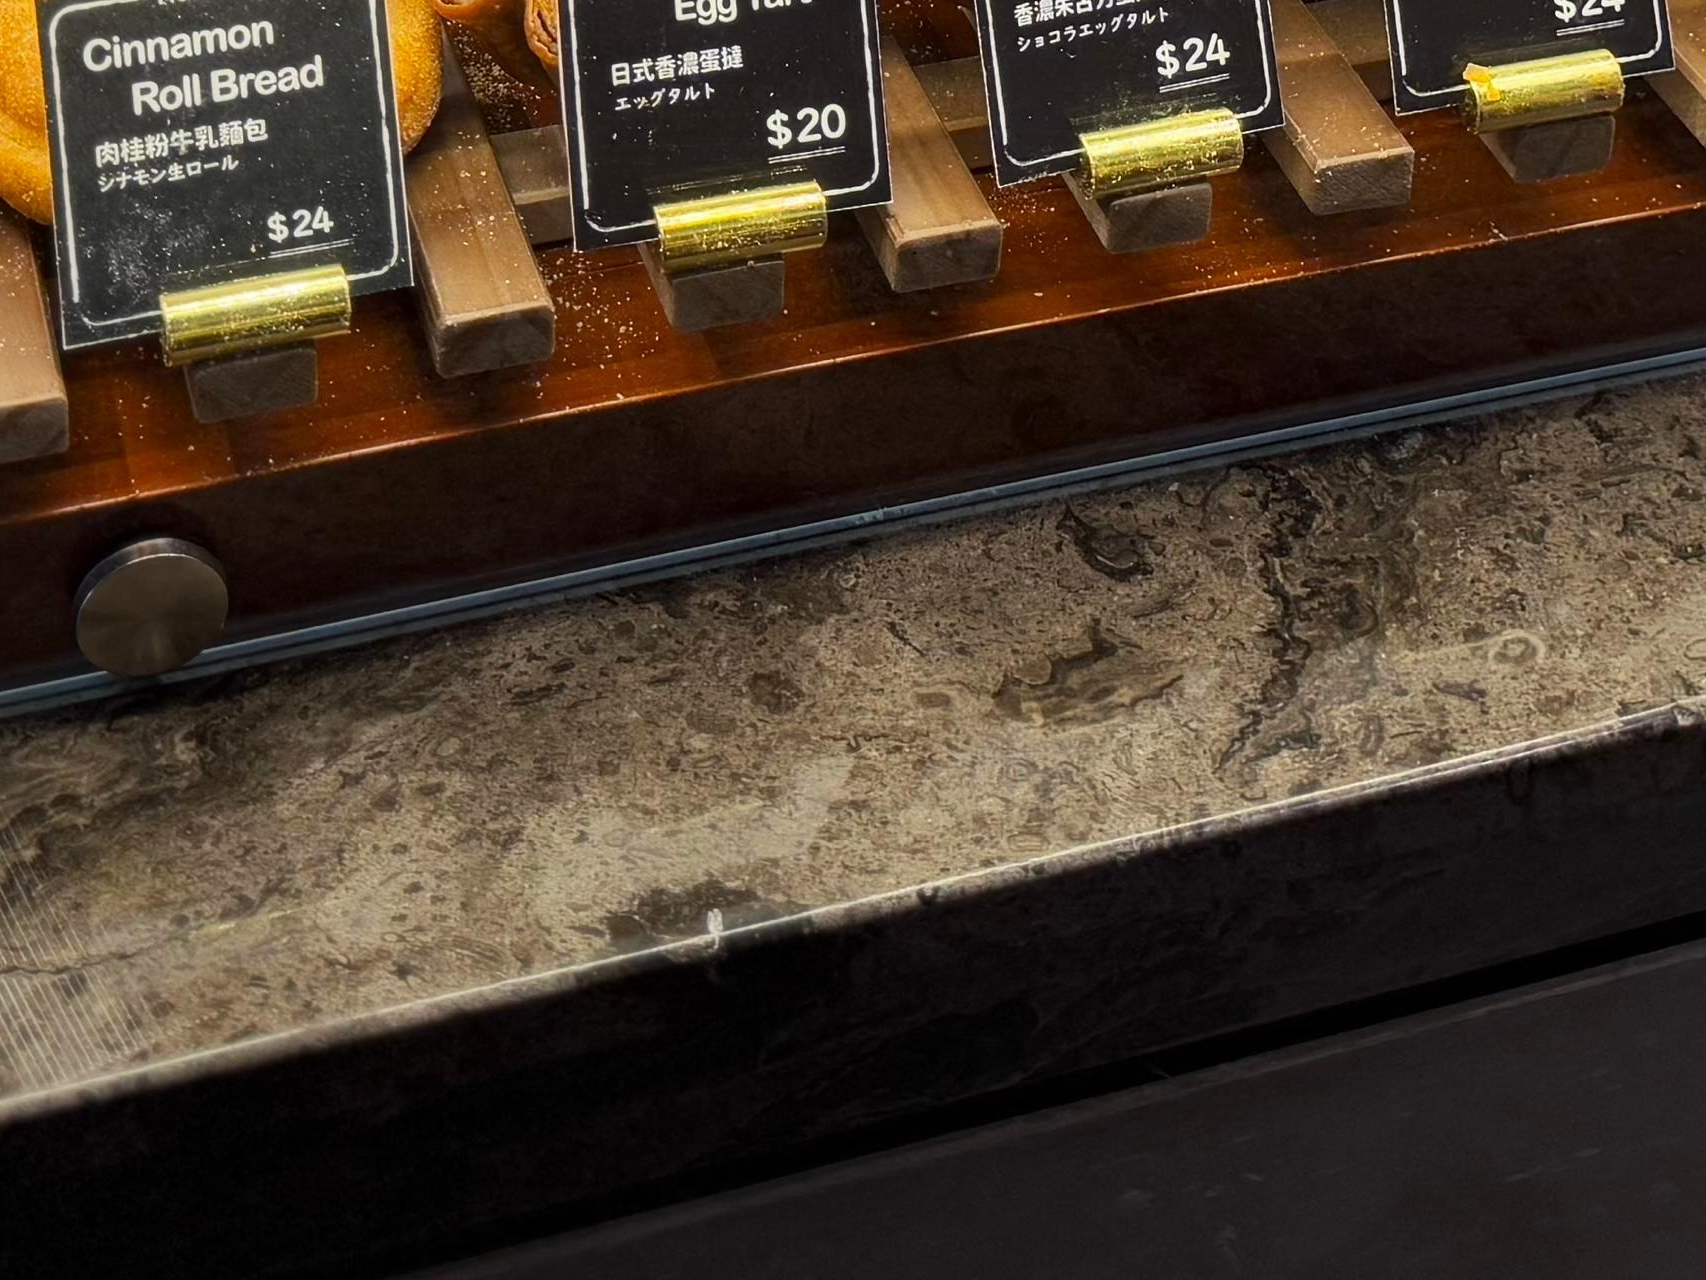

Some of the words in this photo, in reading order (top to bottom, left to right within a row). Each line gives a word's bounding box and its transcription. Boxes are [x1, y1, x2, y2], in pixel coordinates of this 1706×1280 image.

[83, 20, 274, 72] Cinnamon
[1017, 7, 1169, 52] ショコラエッグタルト
[1155, 32, 1231, 78] $24
[132, 73, 202, 116] Roll
[211, 54, 324, 103] Bread
[614, 82, 715, 111] エッグタルト
[766, 103, 846, 148] $20
[97, 155, 239, 193] シナモン生ロール
[267, 206, 334, 243] $24
